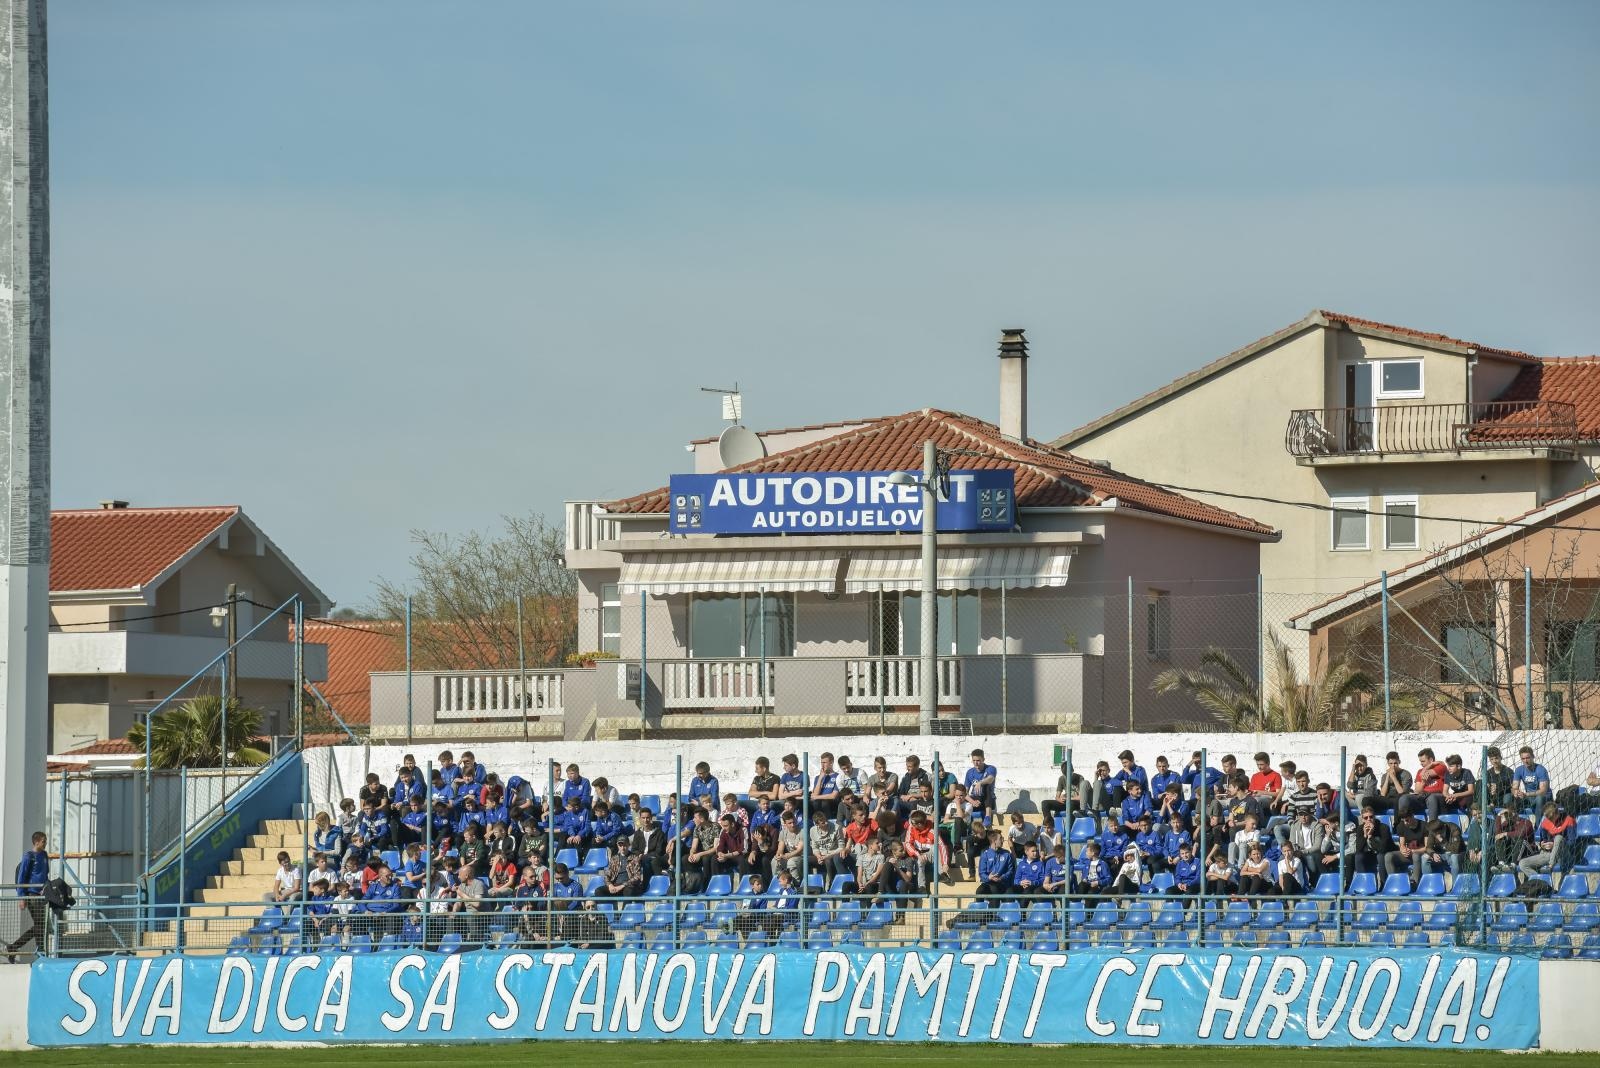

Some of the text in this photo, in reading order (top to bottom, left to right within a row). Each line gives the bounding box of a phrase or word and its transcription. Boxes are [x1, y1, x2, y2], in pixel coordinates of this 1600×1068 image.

[211, 813, 241, 849] EXIT
[60, 957, 184, 1037] SVA
[206, 955, 353, 1034] DICA
[380, 953, 462, 1032] SA
[486, 952, 777, 1035] STANOVA
[802, 950, 1068, 1040] PAMTIT
[1085, 947, 1192, 1038] ĆE
